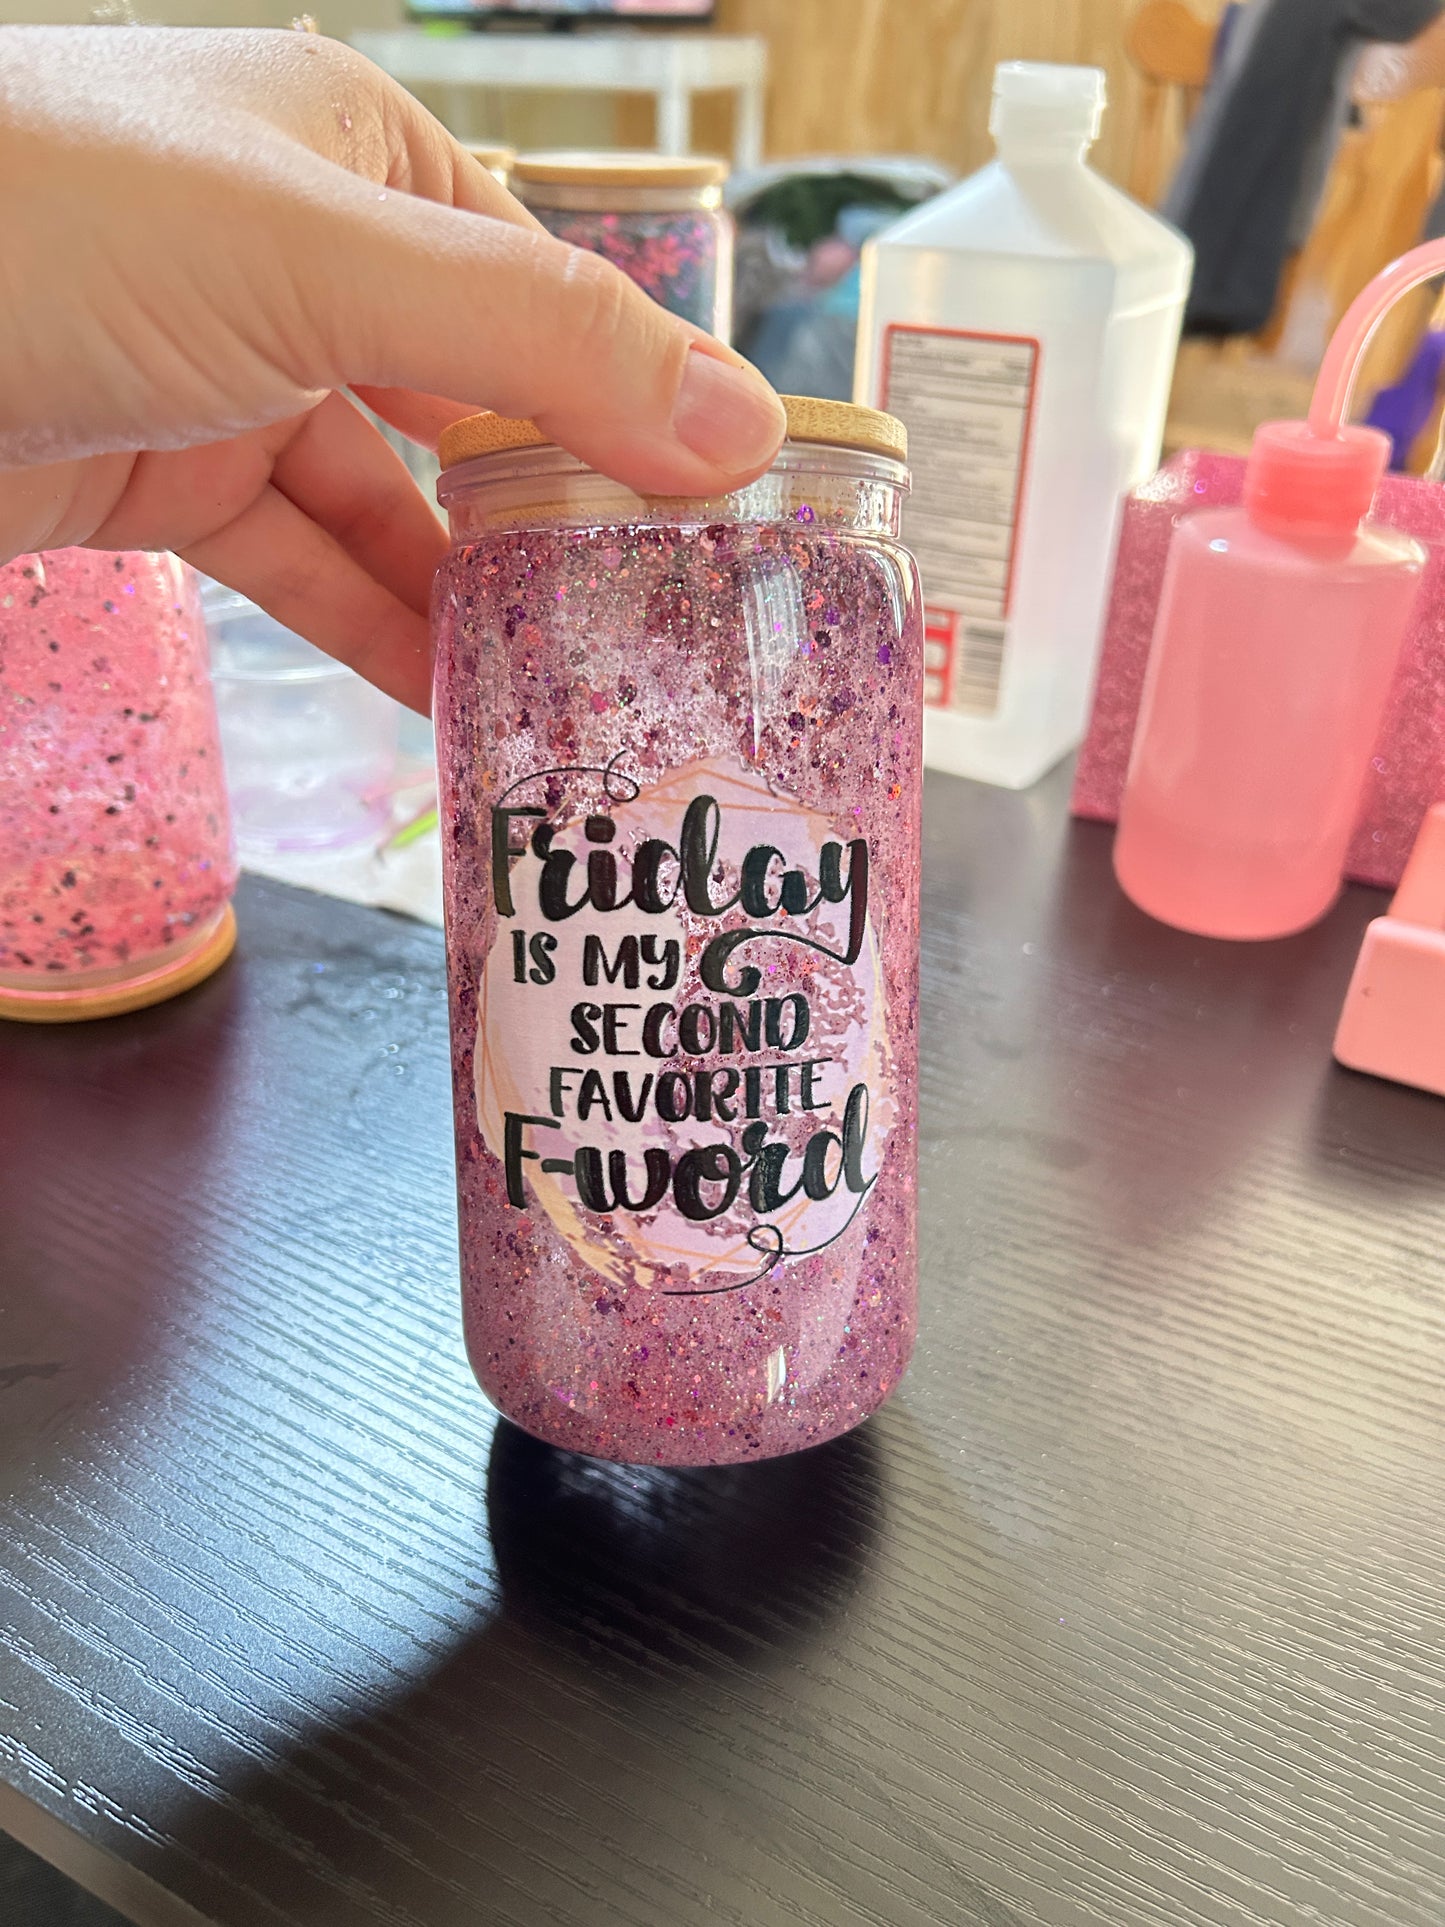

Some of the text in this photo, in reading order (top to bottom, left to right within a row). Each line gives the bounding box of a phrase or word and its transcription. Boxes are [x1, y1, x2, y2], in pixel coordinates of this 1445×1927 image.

[490, 794, 869, 998] Friday
[510, 929, 681, 991] IS MY
[570, 992, 811, 1059] SECOND
[549, 1057, 834, 1123] FAVORITE
[503, 1083, 879, 1223] F-word
